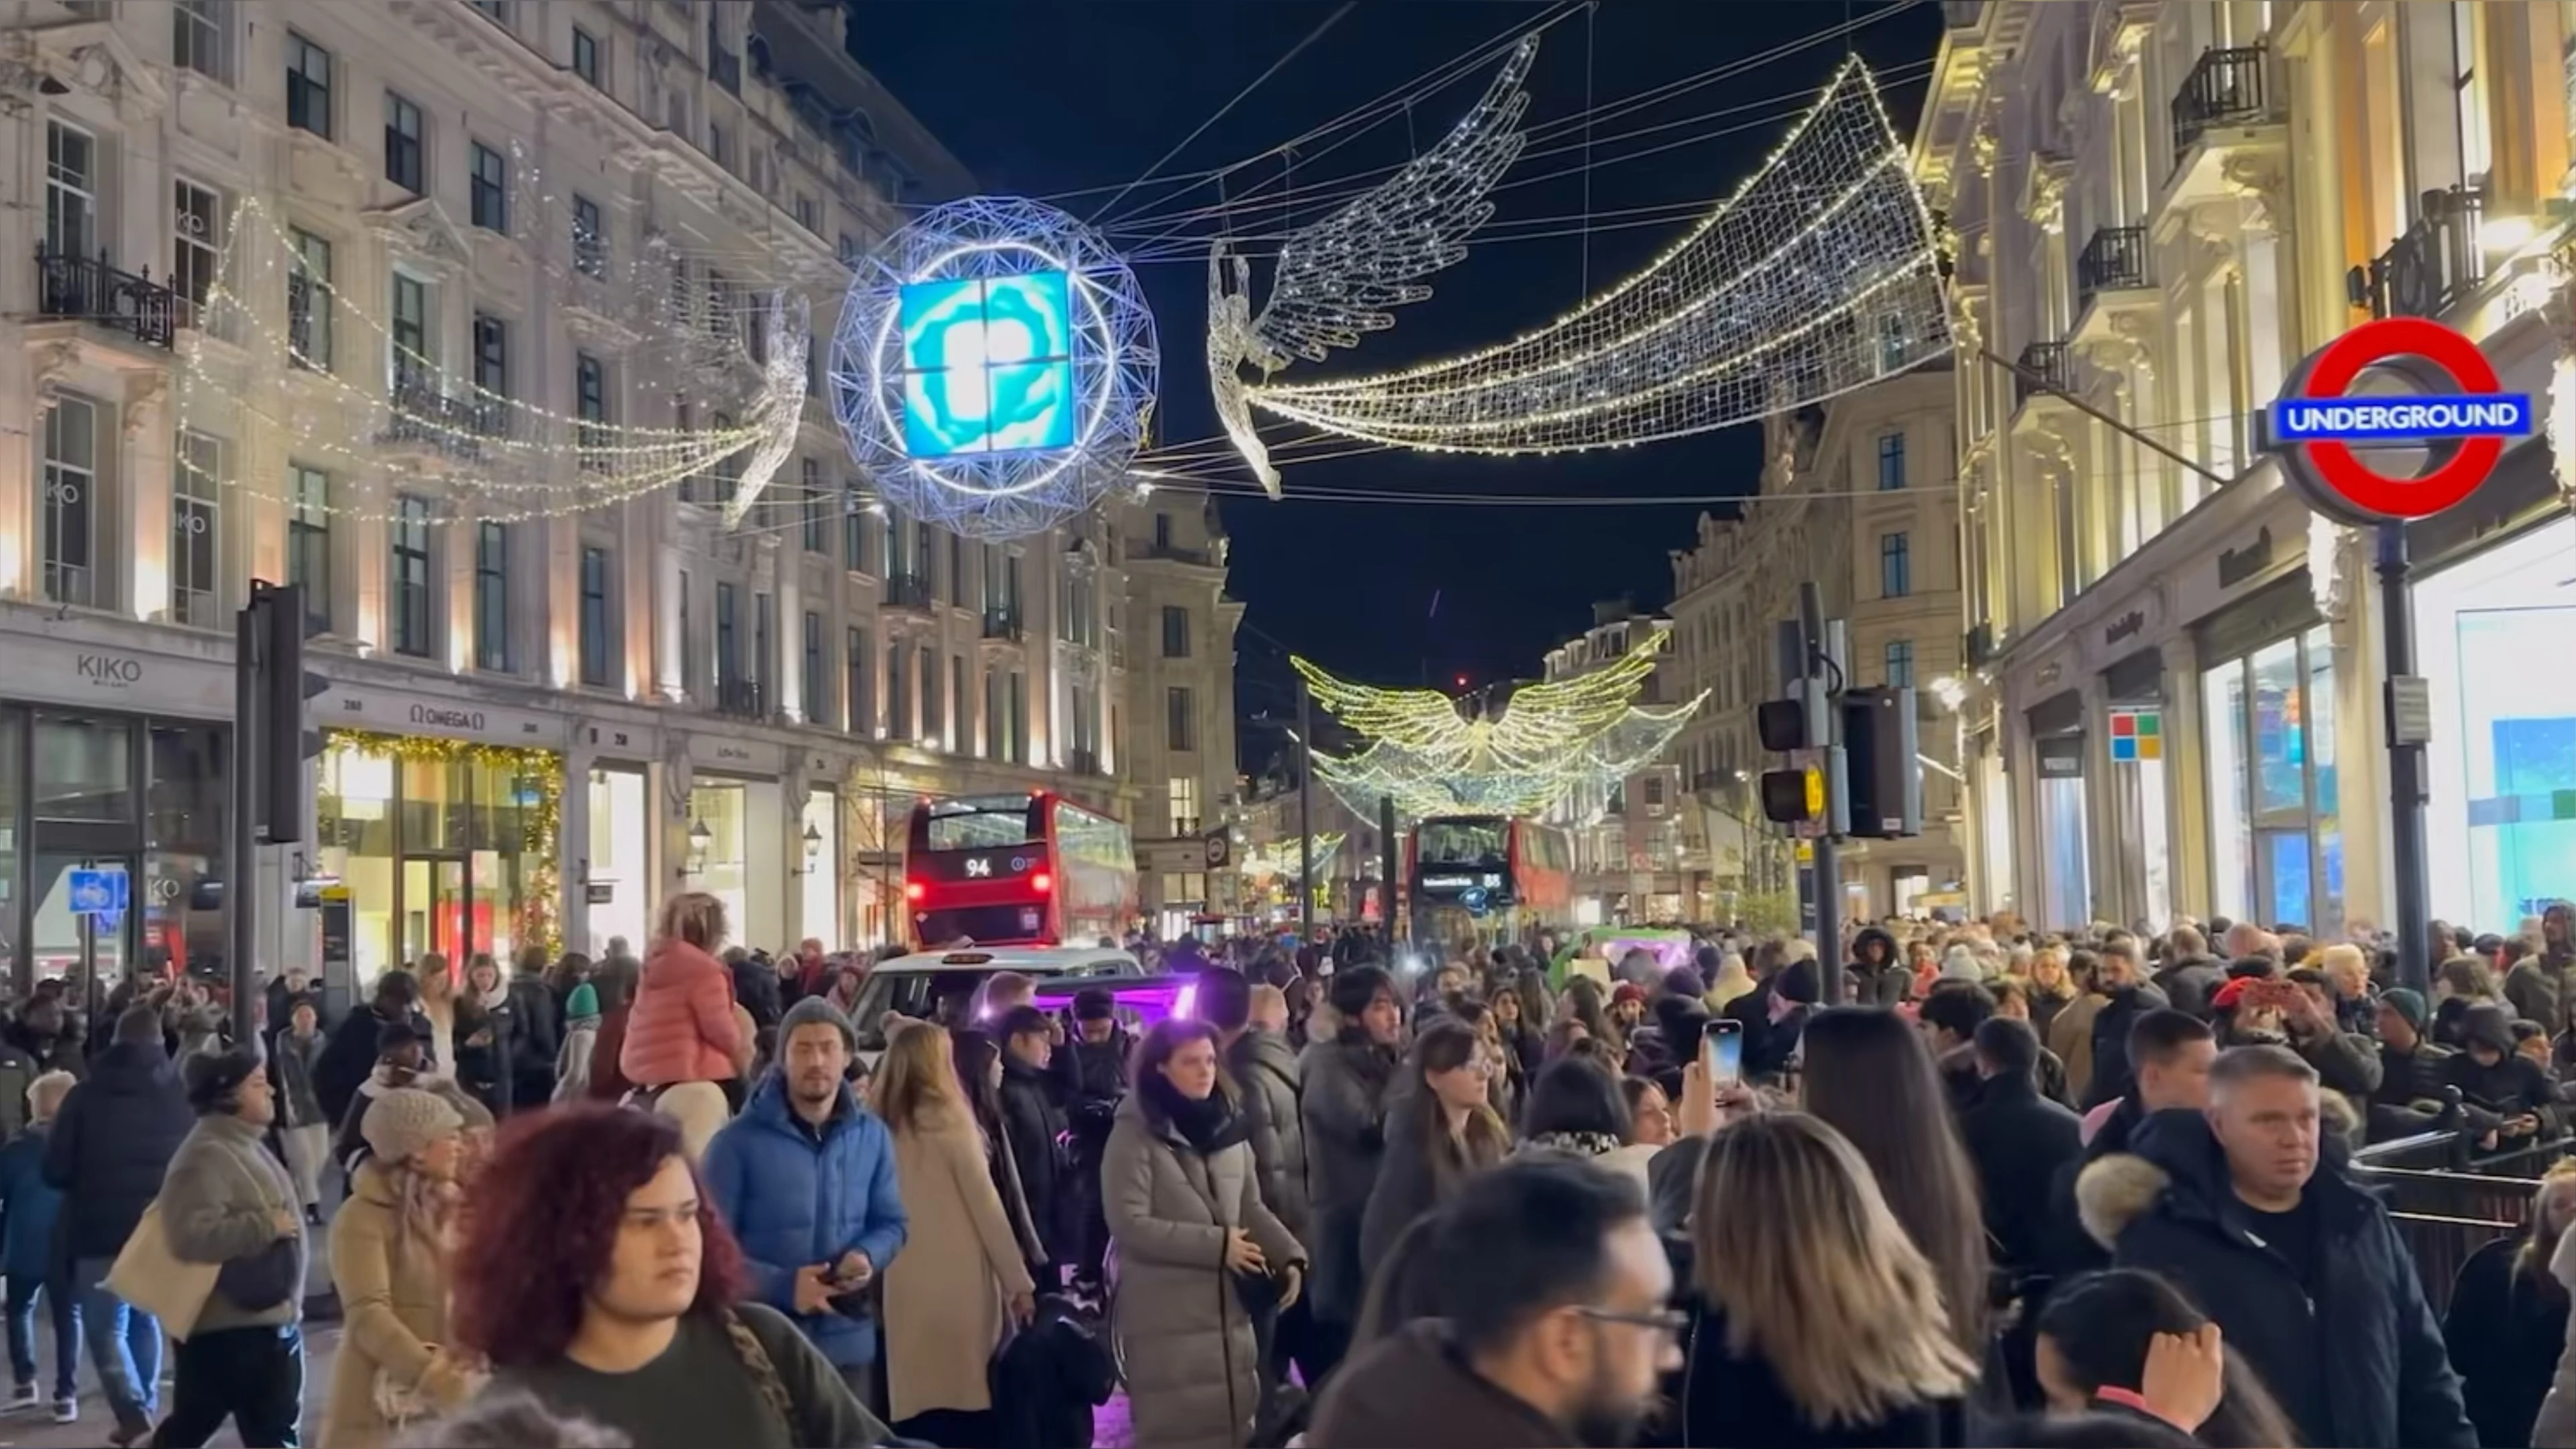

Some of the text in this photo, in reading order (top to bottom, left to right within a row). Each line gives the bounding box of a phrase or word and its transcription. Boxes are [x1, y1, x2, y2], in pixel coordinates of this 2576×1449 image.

[2288, 403, 2519, 431] UNDERGROUND
[78, 653, 142, 682] KIKO
[425, 708, 471, 728] OMEGA
[966, 859, 991, 877] 94
